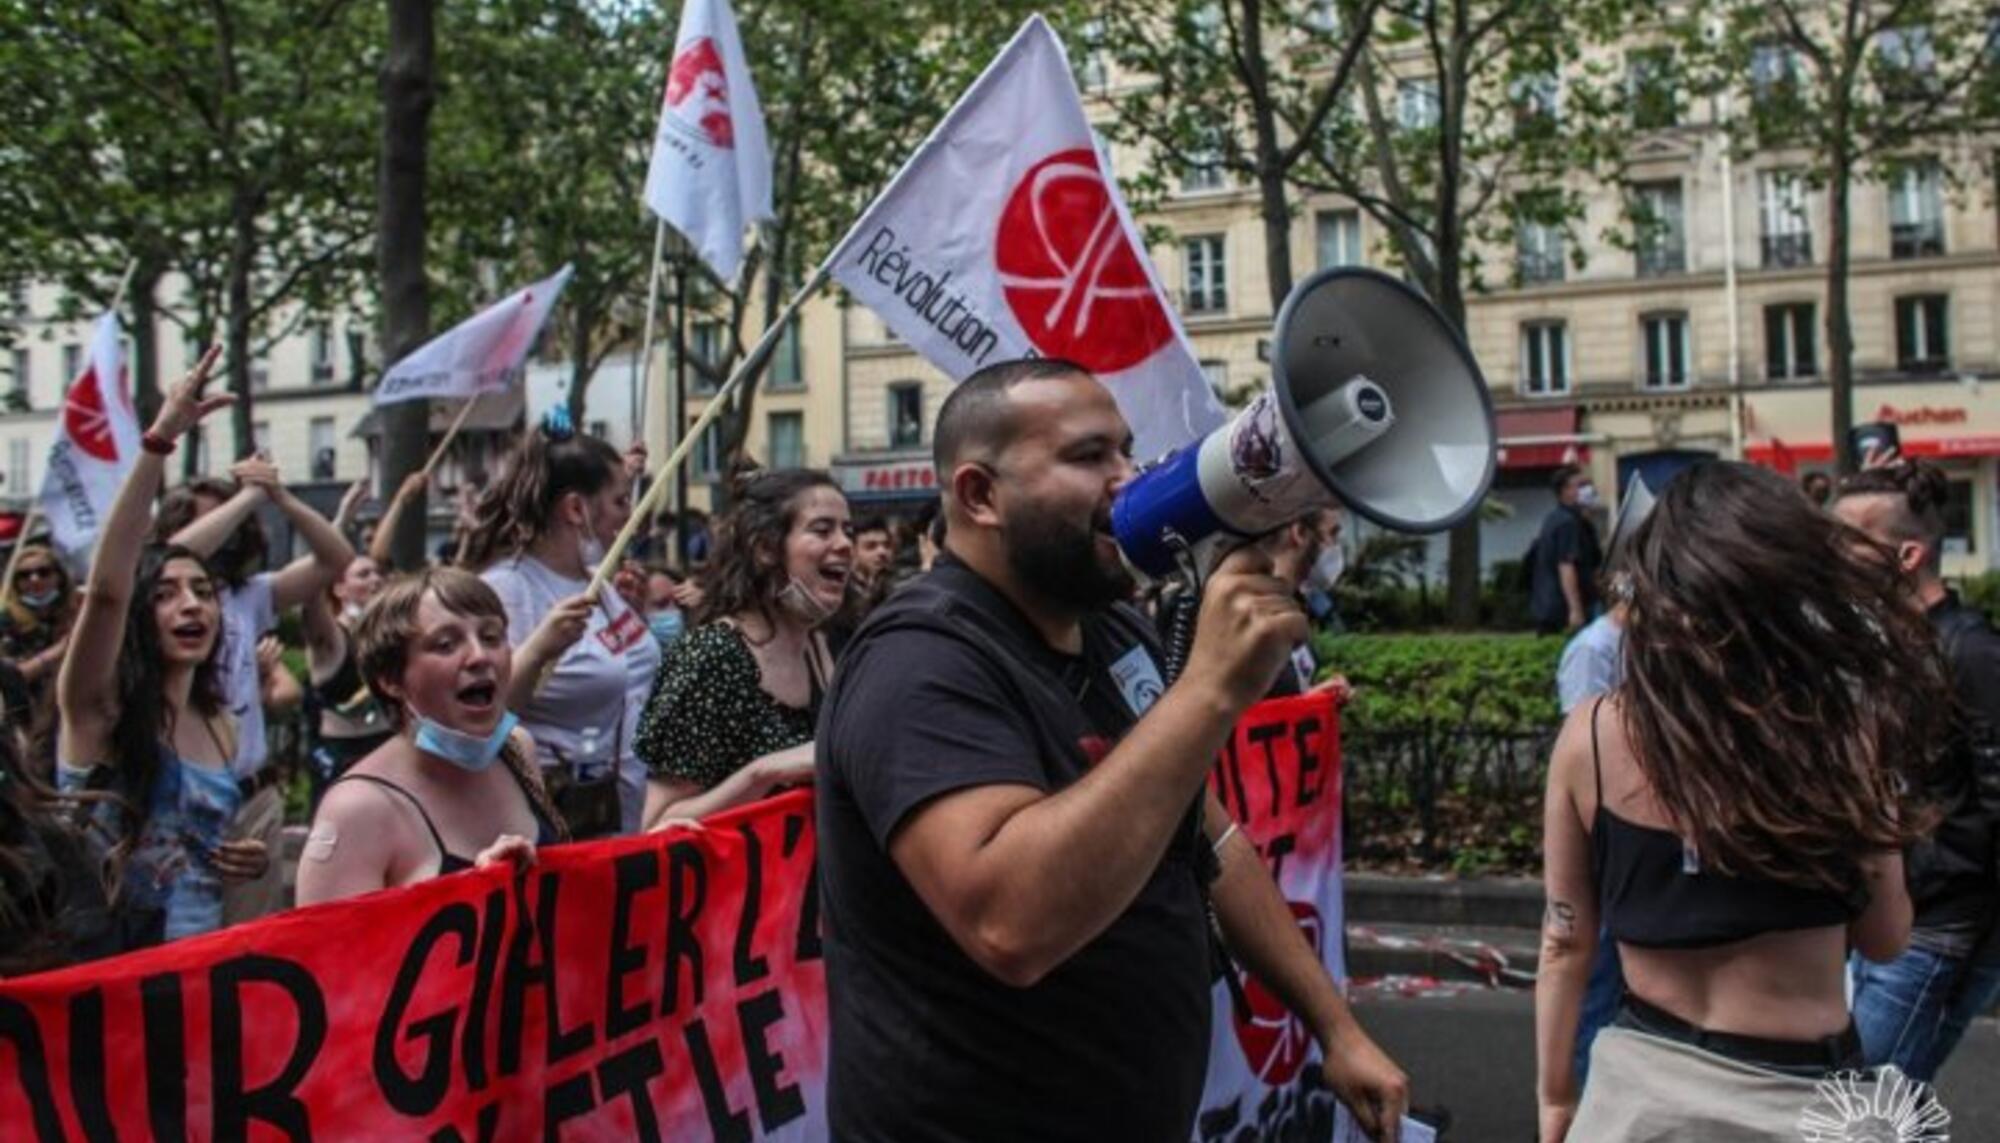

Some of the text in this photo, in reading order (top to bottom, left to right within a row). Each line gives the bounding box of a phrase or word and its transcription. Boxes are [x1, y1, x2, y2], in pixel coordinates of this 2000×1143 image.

[857, 226, 998, 366] Révolution
[1877, 404, 1967, 425] Auchan
[1215, 717, 1321, 824] ITE
